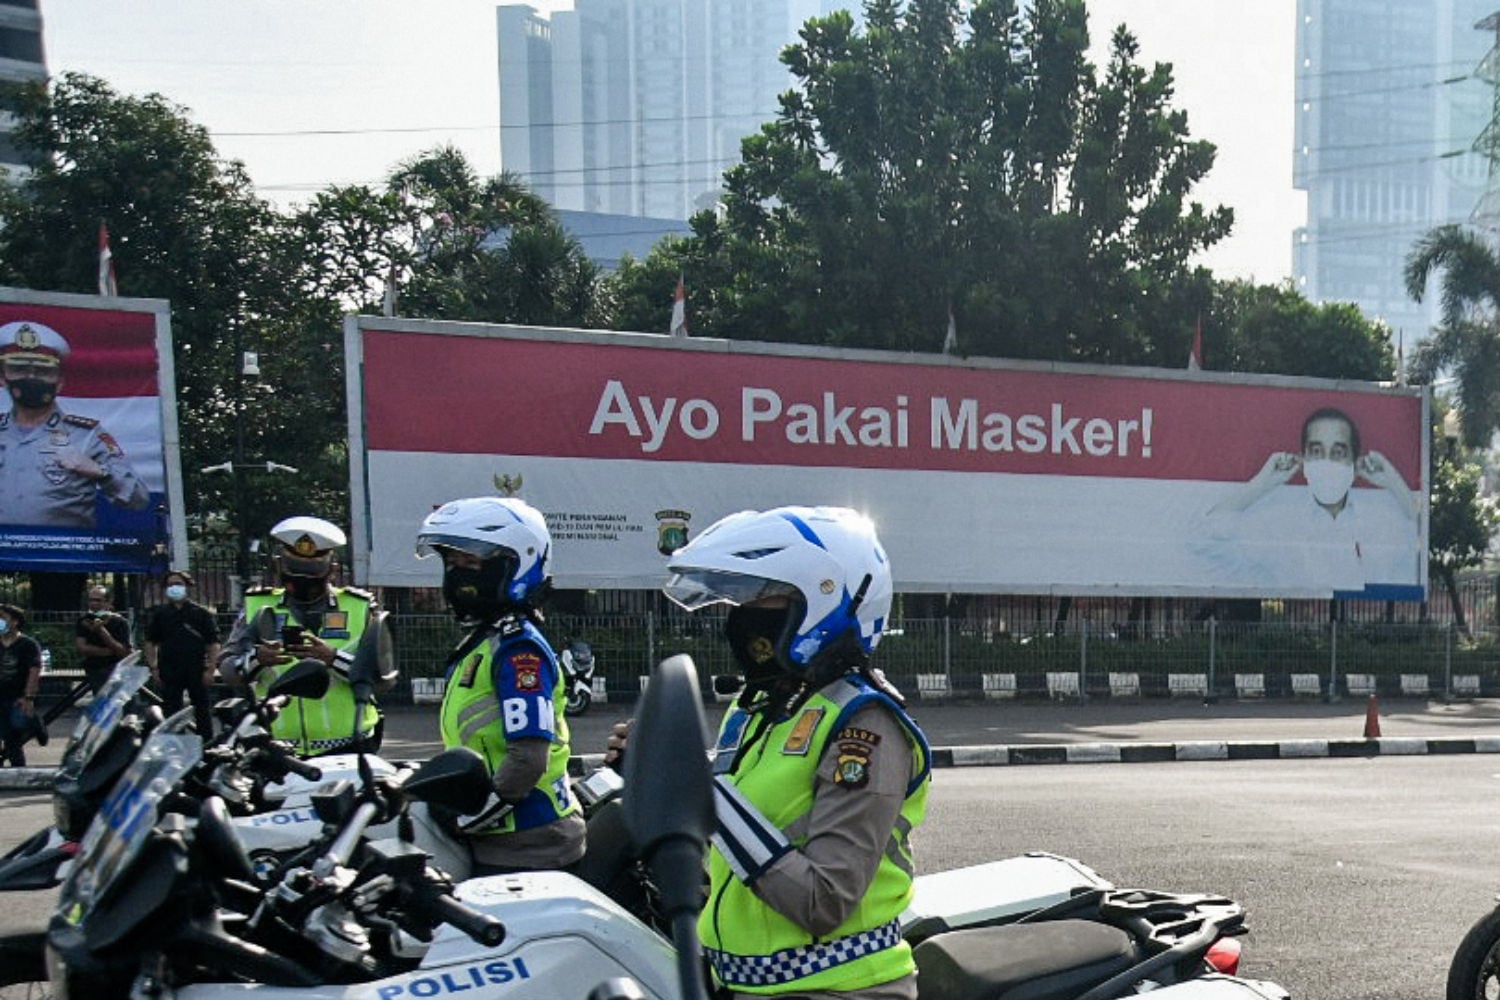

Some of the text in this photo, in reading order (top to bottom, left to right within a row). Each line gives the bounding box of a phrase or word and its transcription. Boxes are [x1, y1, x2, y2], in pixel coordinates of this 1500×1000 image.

[588, 378, 1153, 458] Ayo Pakai Masker!
[252, 807, 322, 827] POLI
